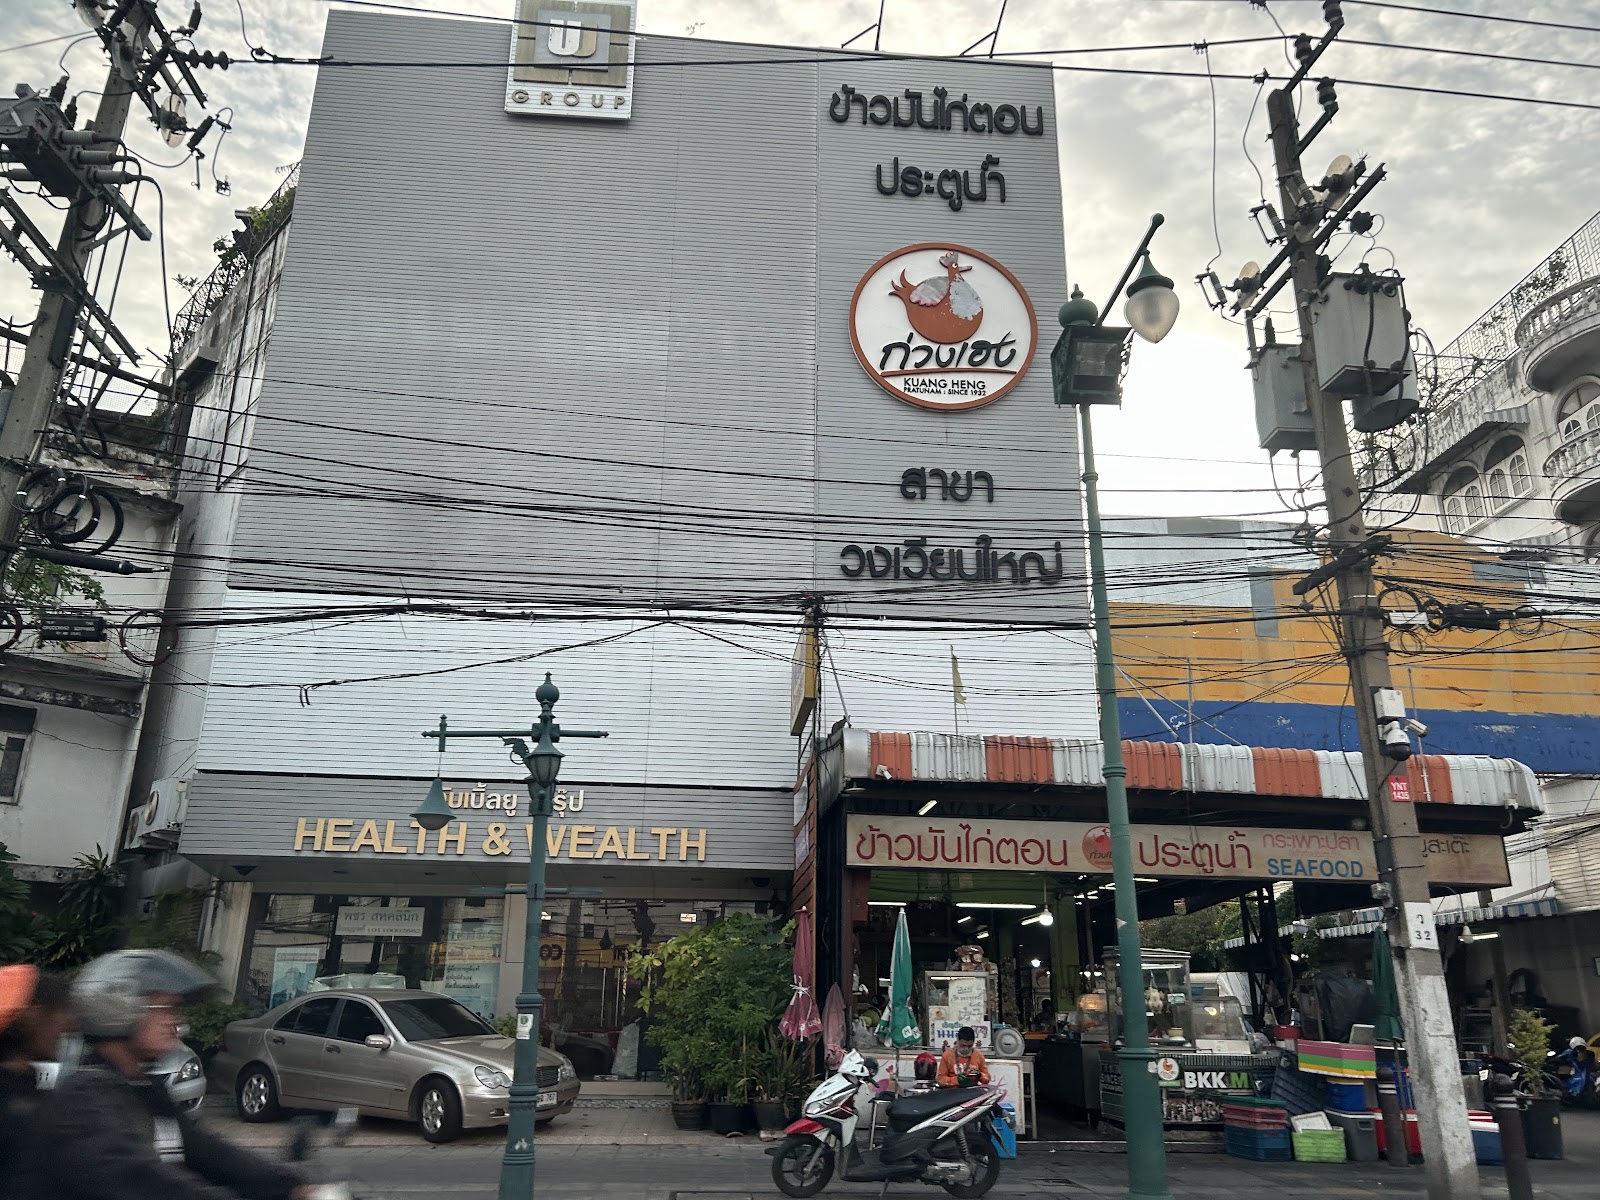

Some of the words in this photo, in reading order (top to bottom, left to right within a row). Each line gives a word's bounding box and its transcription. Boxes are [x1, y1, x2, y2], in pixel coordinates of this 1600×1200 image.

[511, 89, 625, 110] GROUP
[829, 83, 1043, 136] ข้าวมันไก่ตอน
[876, 153, 1006, 212] ประตูน้ำ
[903, 377, 948, 388] KUANG
[951, 379, 986, 389] HENG
[903, 386, 942, 395] PRATUNAM
[948, 388, 968, 396] SINCE
[900, 466, 994, 503] สาขา
[840, 534, 1063, 585] วงเวียนใหญ่
[442, 782, 518, 818] ับเบิ้ลยู
[293, 816, 468, 855] HEALTH
[482, 822, 512, 856] &
[525, 824, 707, 861] WEALTH
[856, 822, 1068, 866] ข้าวมันไก่ตอน
[1138, 830, 1252, 874] ประตูน้ำ
[1267, 858, 1363, 878] SEAFOOD
[1415, 930, 1431, 940] 32
[1184, 1071, 1228, 1088] BKK
[1231, 1072, 1249, 1088] M
